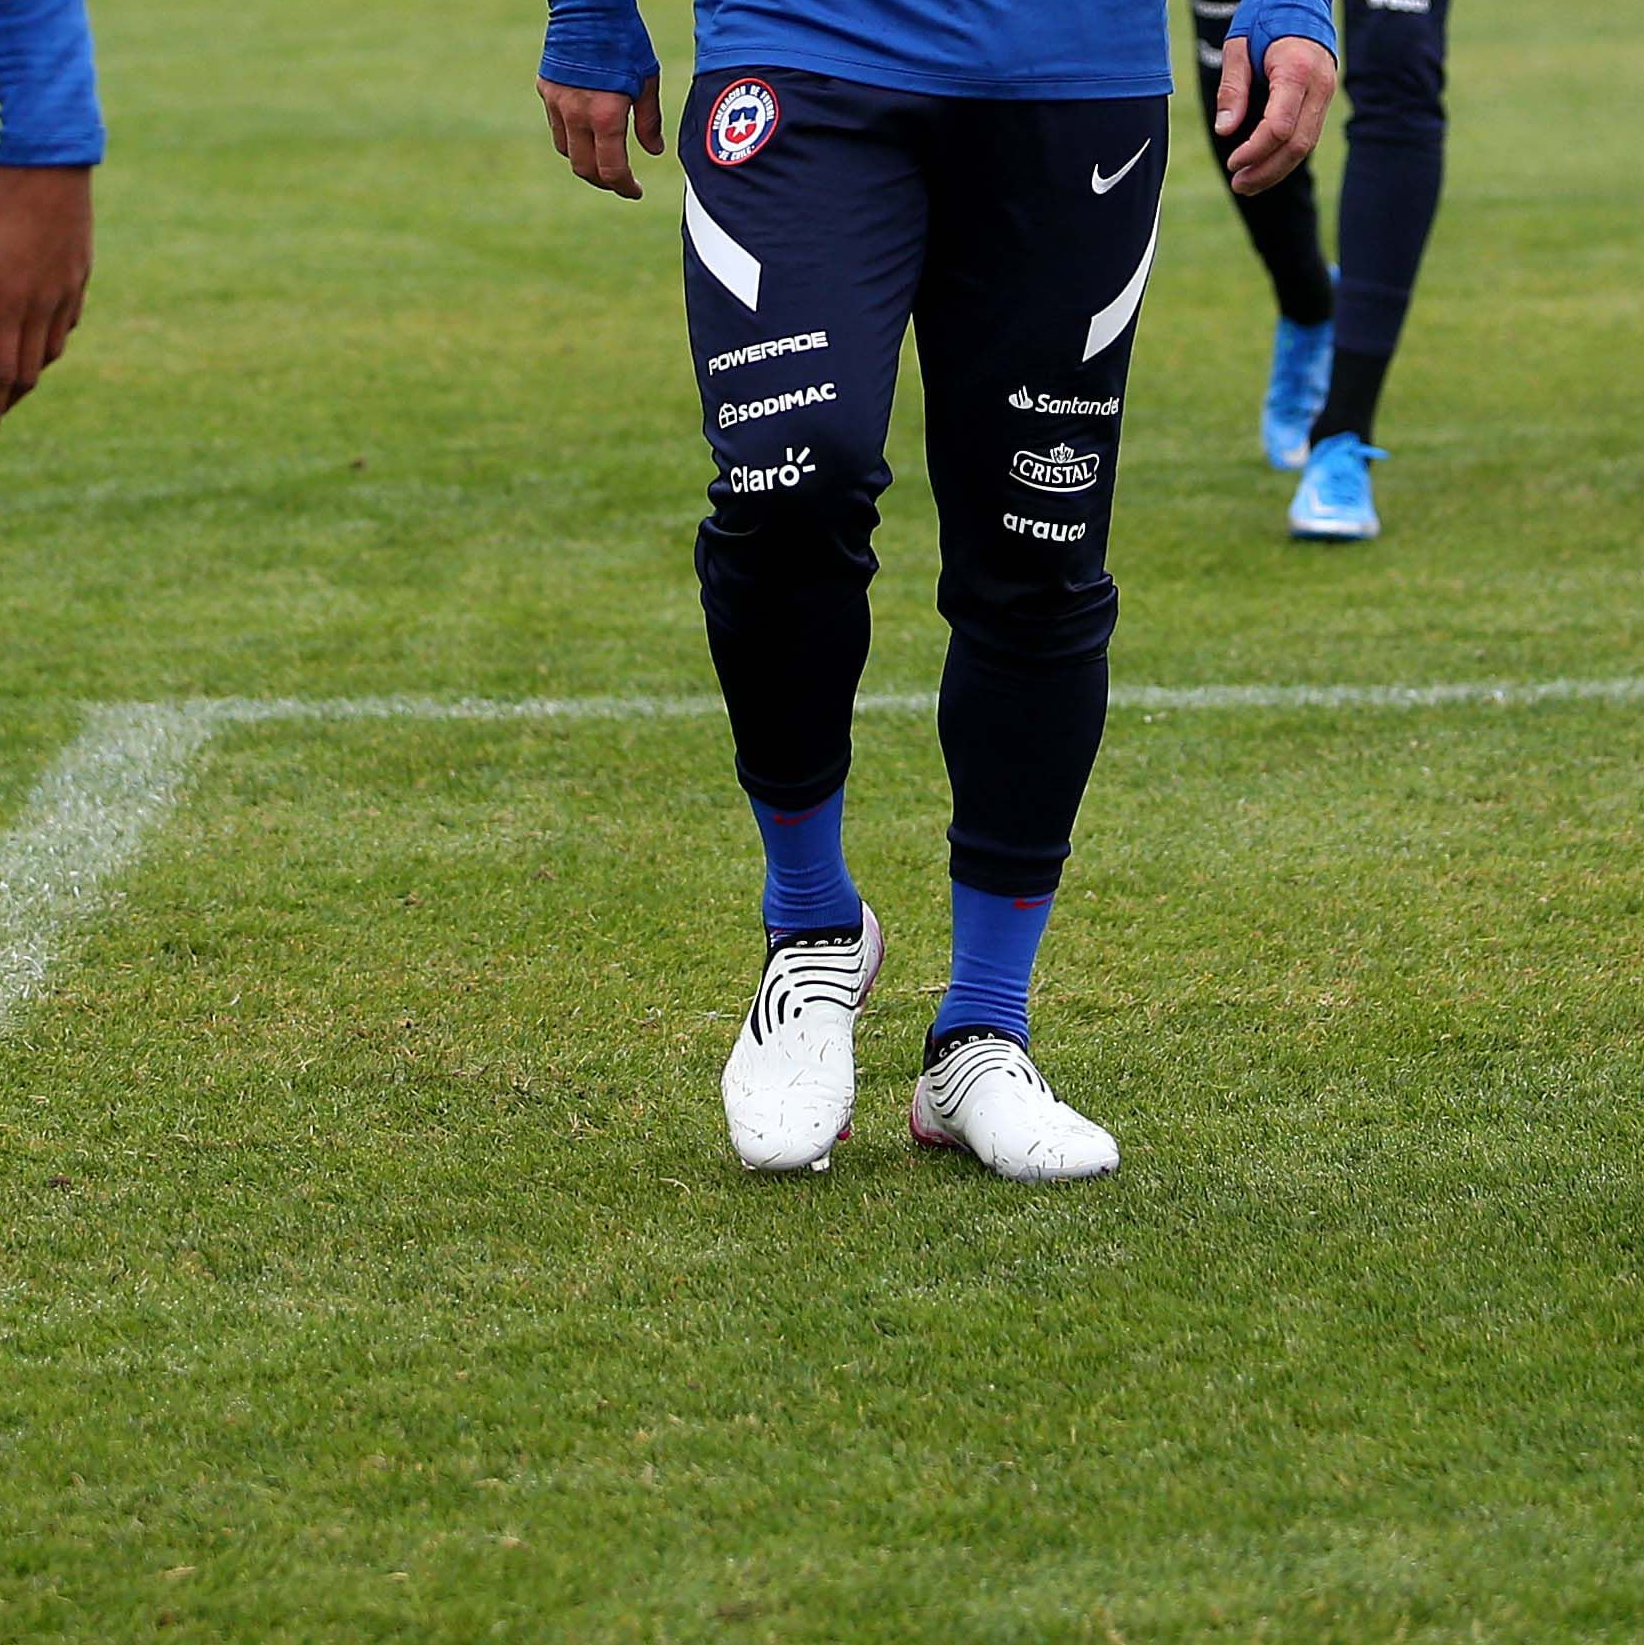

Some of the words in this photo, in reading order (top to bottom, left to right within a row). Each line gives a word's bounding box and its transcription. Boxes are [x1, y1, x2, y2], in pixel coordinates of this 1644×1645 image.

[708, 331, 829, 376] POWERADE
[738, 382, 837, 422] SODIMAC
[729, 464, 801, 494] Claro
[1019, 459, 1093, 484] CRISTAL
[1002, 512, 1086, 542] arauco
